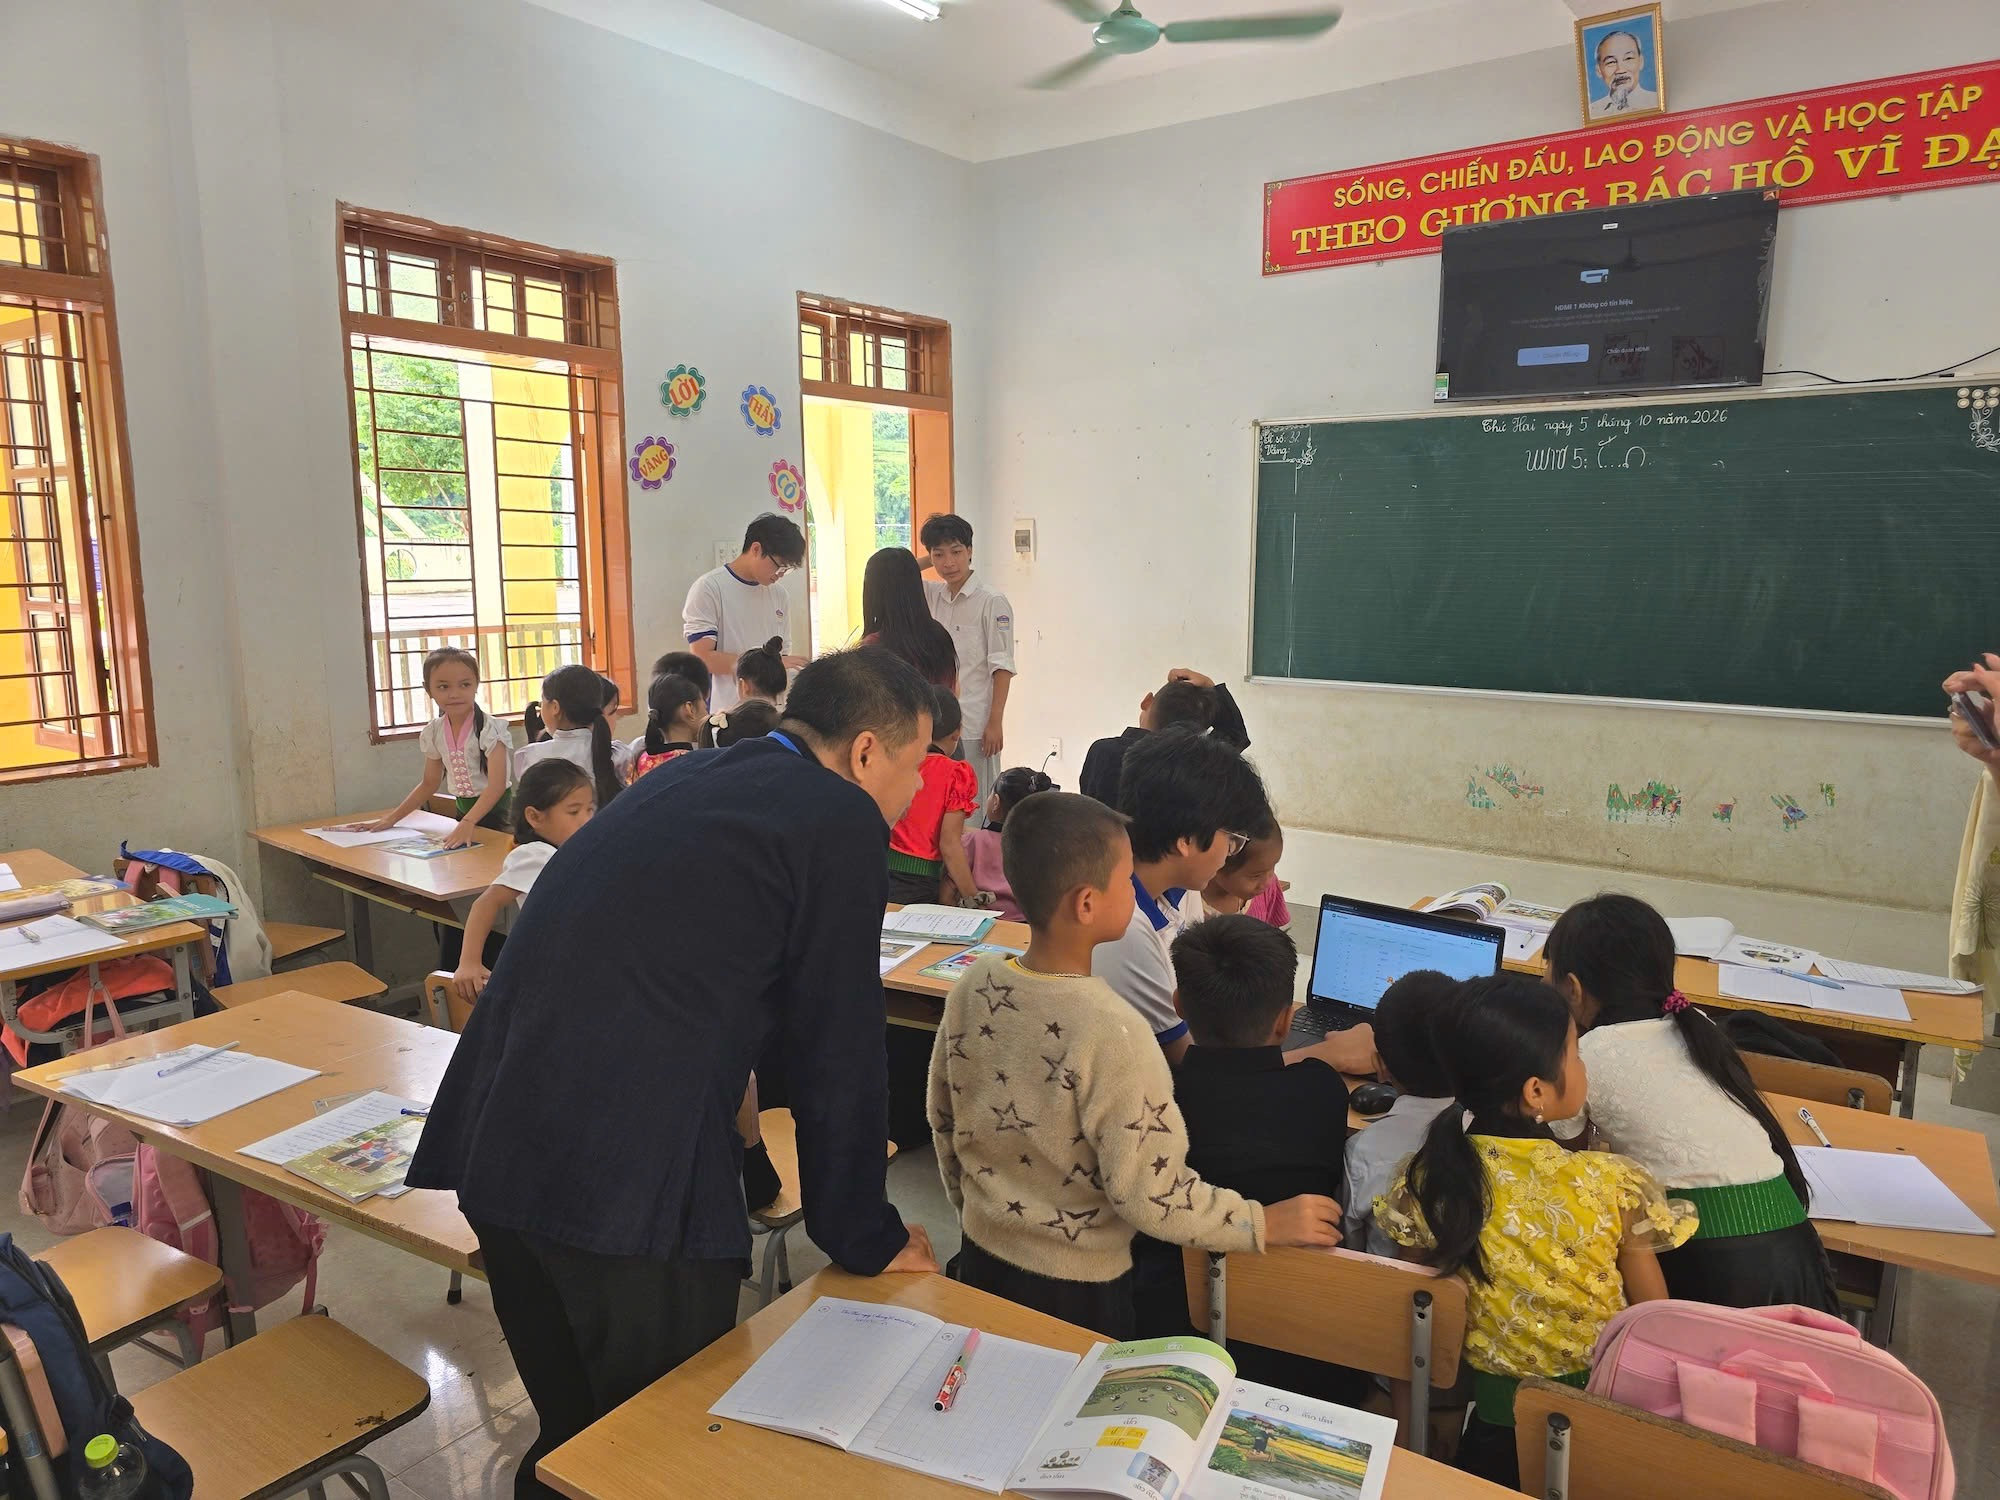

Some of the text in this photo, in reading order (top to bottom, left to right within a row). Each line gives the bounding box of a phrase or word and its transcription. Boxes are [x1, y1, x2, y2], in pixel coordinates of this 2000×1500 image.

[1333, 83, 1983, 208] SỐNG, CHIẾN ĐẤU, LAO ĐỘNG VÀ HỌC TẬP
[1291, 214, 1407, 255] THEO
[1419, 187, 1590, 237] GƯƠNG
[1605, 165, 1712, 206] BÁC
[1729, 138, 1815, 190] HỒ
[1834, 134, 1903, 179] VĨ
[1554, 303, 1572, 312] HDMI
[1481, 408, 1729, 437] Thứ Hai ngày 5 tháng 10 năm 2026
